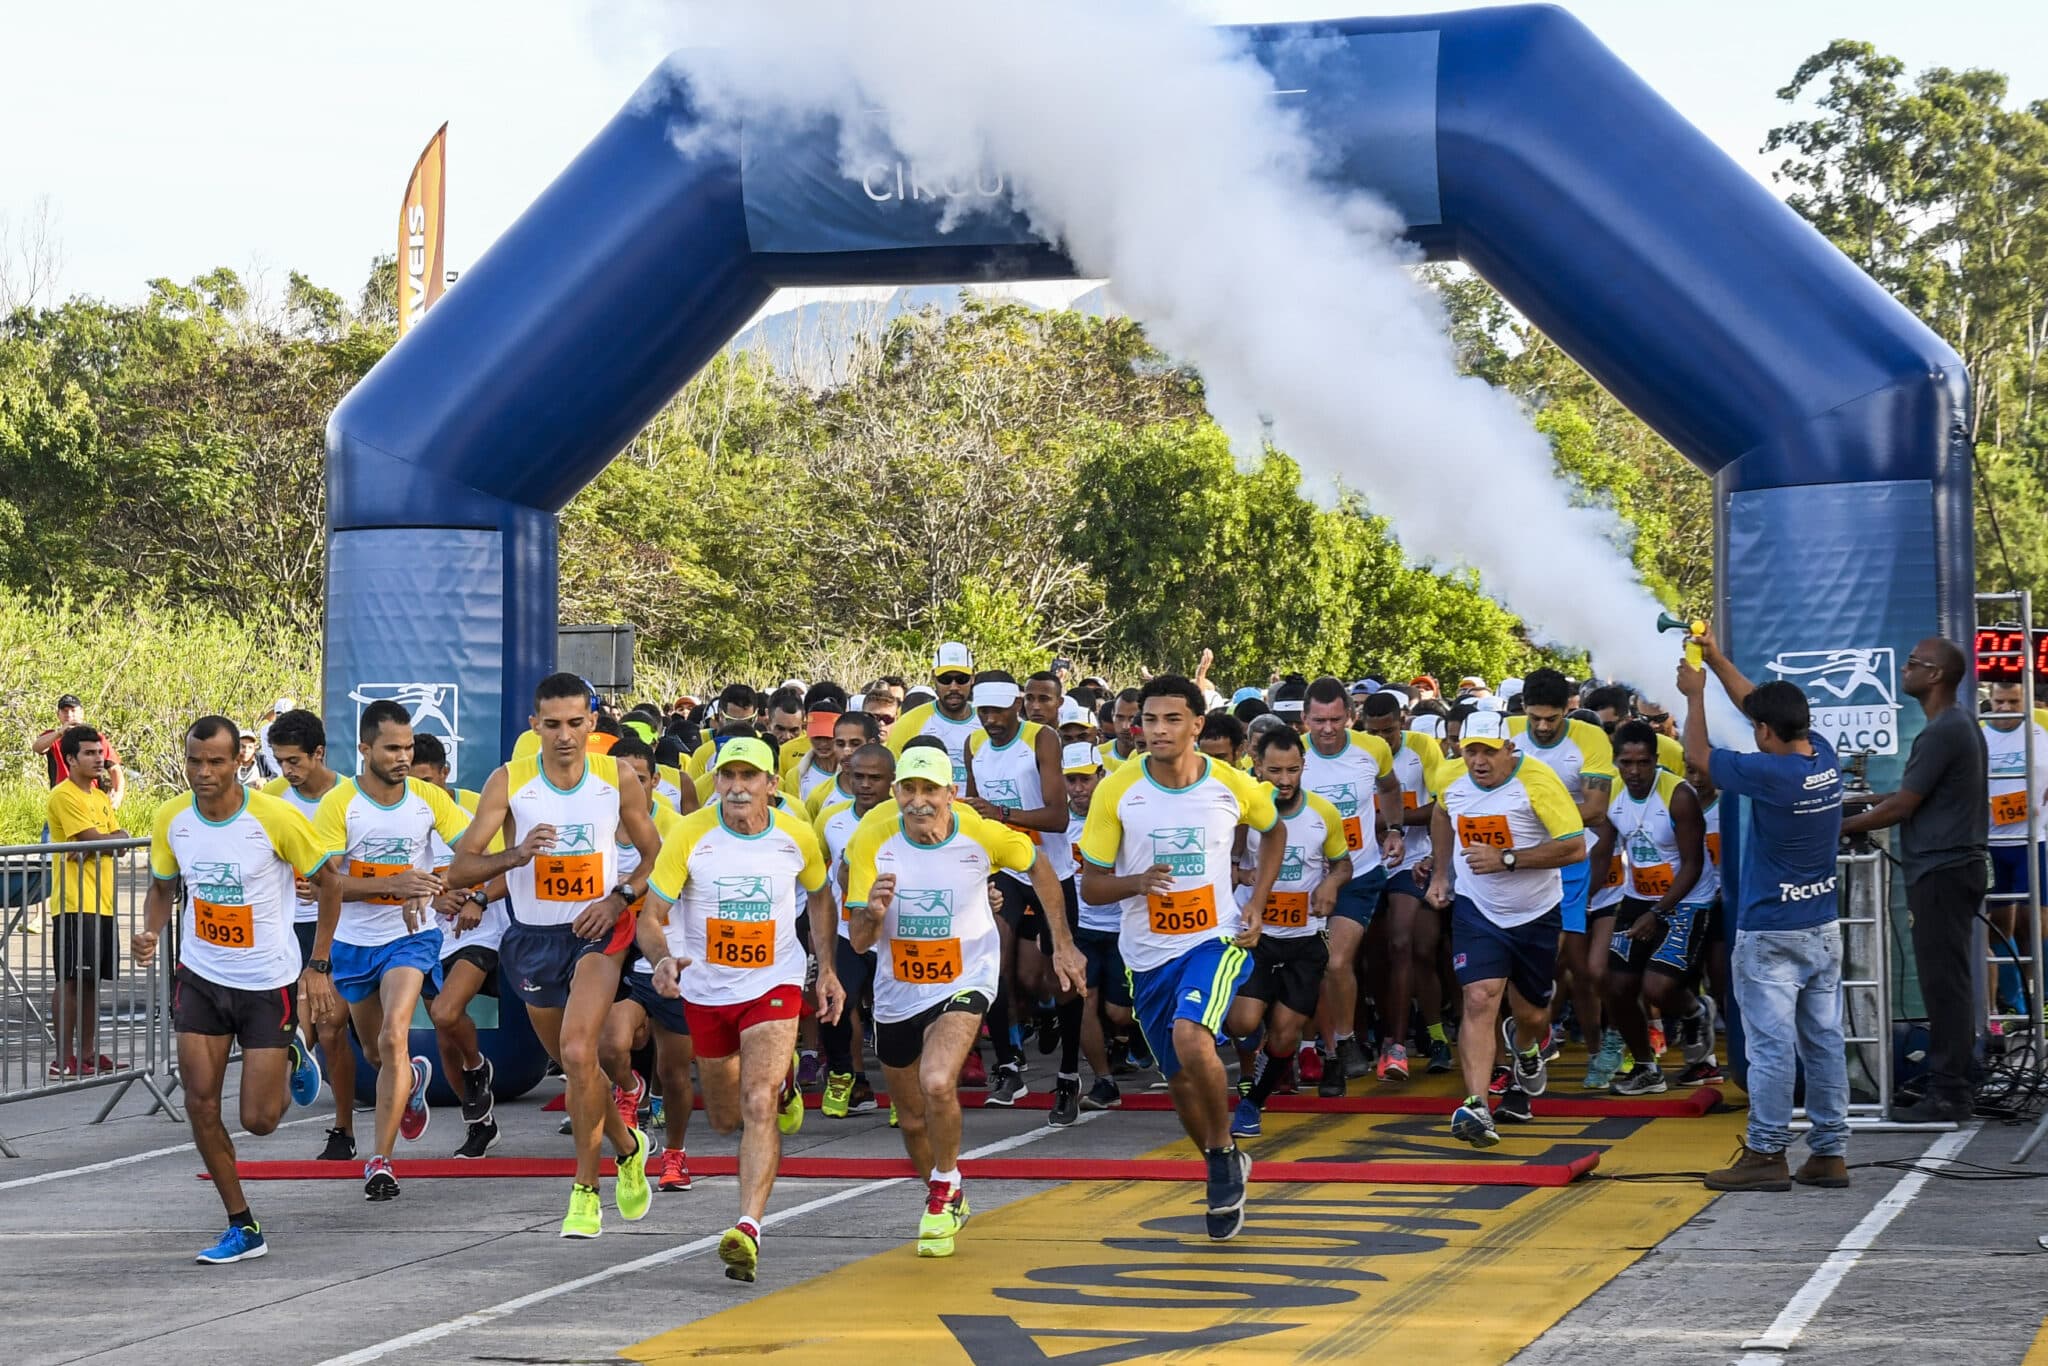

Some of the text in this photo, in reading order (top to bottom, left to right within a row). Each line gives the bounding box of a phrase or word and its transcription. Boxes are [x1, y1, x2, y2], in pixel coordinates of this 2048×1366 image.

[863, 161, 1005, 201] CIRCU
[1809, 710, 1891, 728] RCUITO
[1836, 729, 1891, 751] AÇO
[1997, 805, 2028, 821] 194
[1463, 831, 1506, 846] 1975
[1155, 855, 1204, 864] CIRCUITO
[1178, 863, 1204, 874] AÇO
[1281, 871, 1302, 881] AÇO
[543, 875, 595, 897] 1941
[218, 893, 242, 904] AÇO
[720, 902, 769, 911] CIRCUITO
[720, 910, 769, 922] DO AÇO
[900, 918, 950, 926] CIRCUITO
[1155, 908, 1208, 930] 2050
[200, 919, 245, 944] 1993
[899, 926, 949, 937] DO AÇO
[714, 941, 767, 963] 1856
[899, 960, 954, 980] 1954
